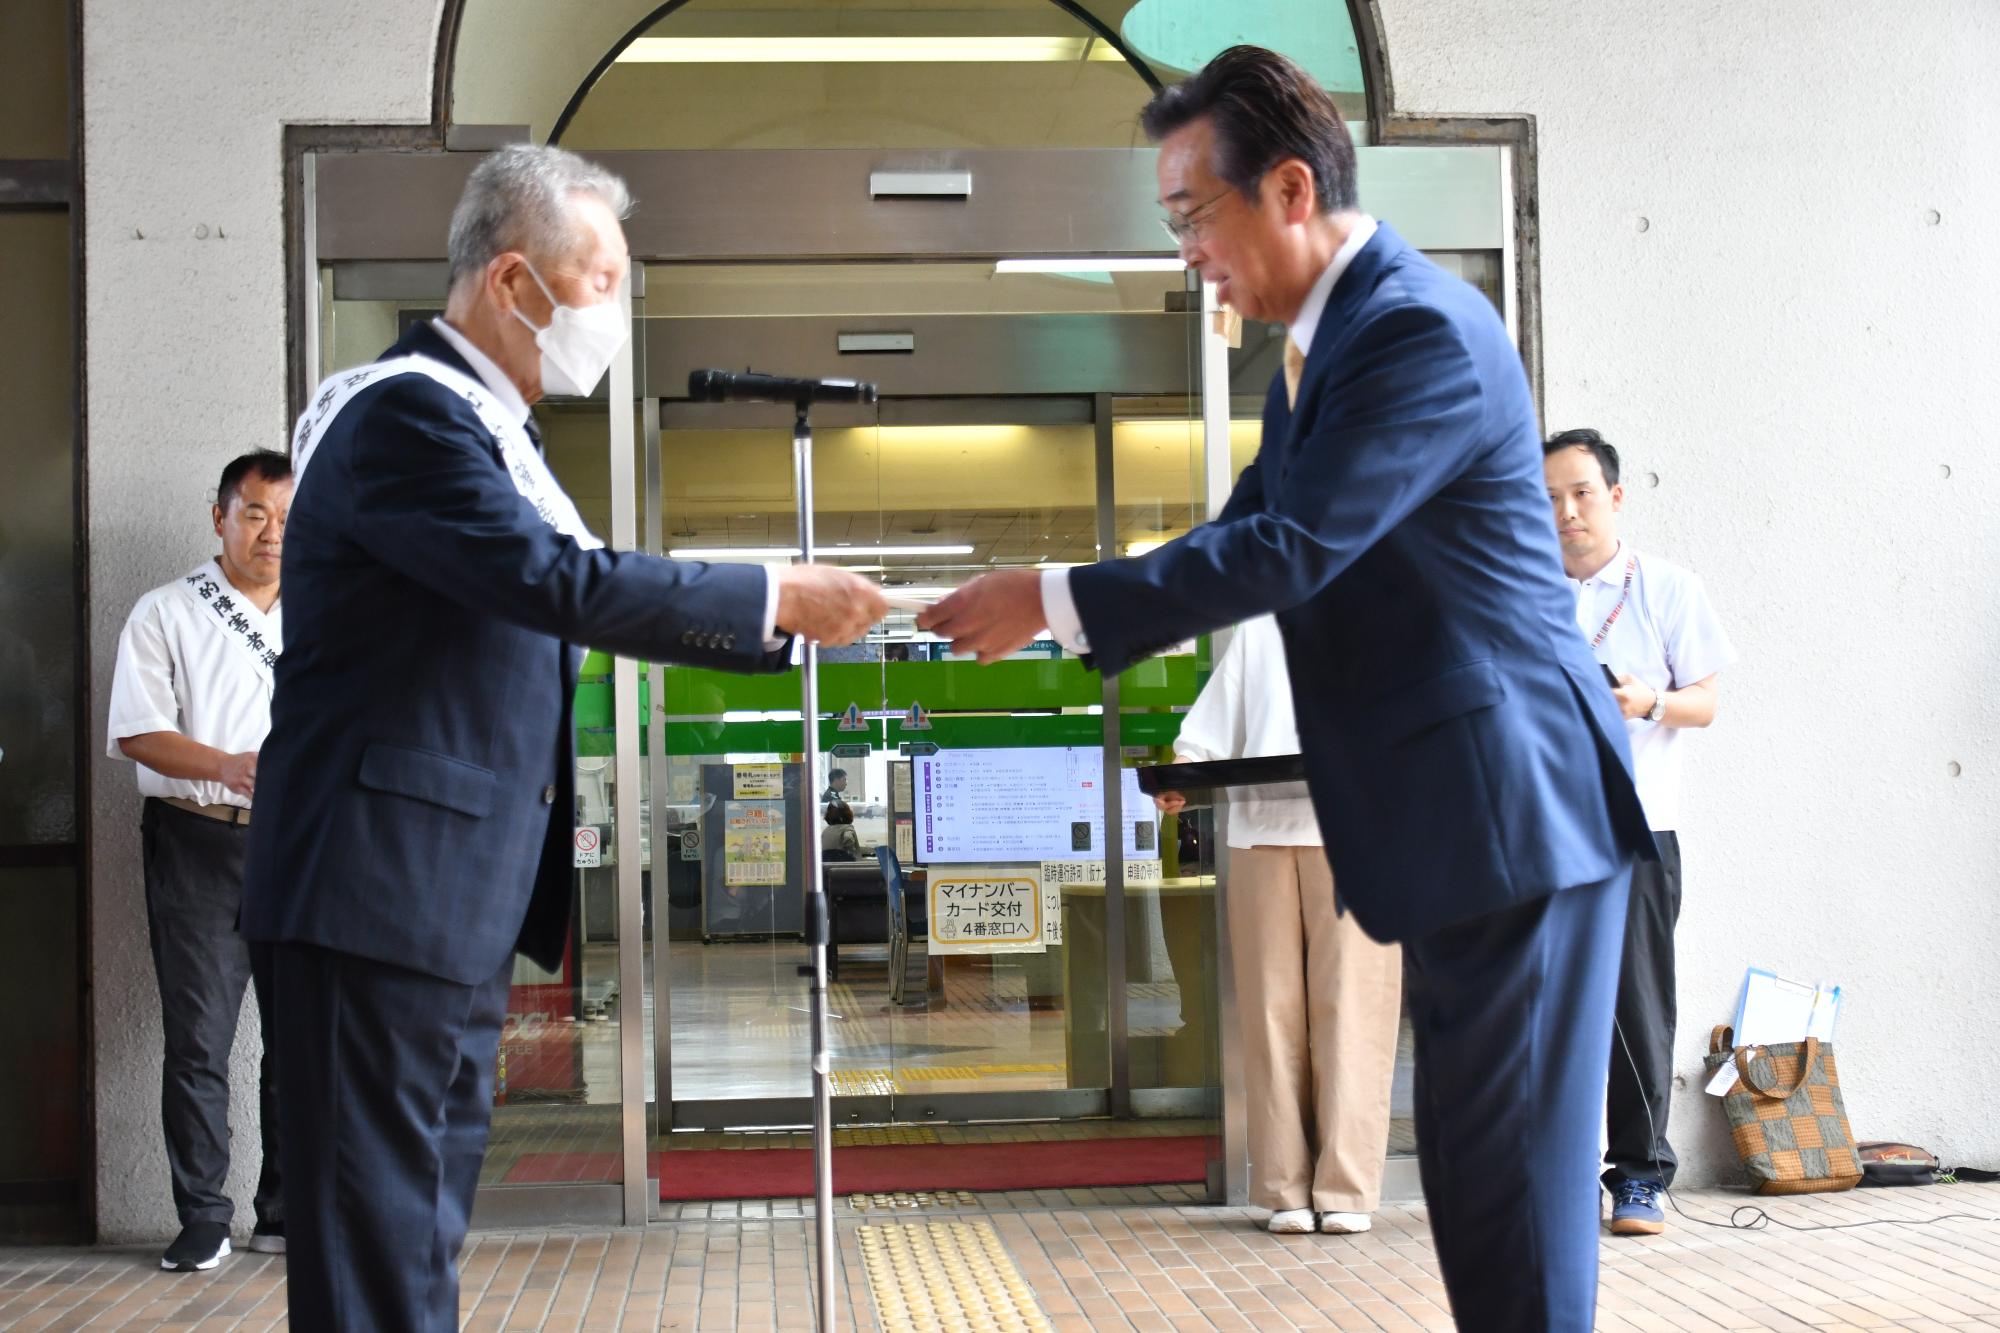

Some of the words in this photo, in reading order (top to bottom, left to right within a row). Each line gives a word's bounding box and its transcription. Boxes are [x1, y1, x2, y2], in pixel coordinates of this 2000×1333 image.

[940, 882, 1030, 899] マイナンバー
[946, 901, 1023, 917] カード交付
[962, 921, 1030, 936] 4番窓口へ
